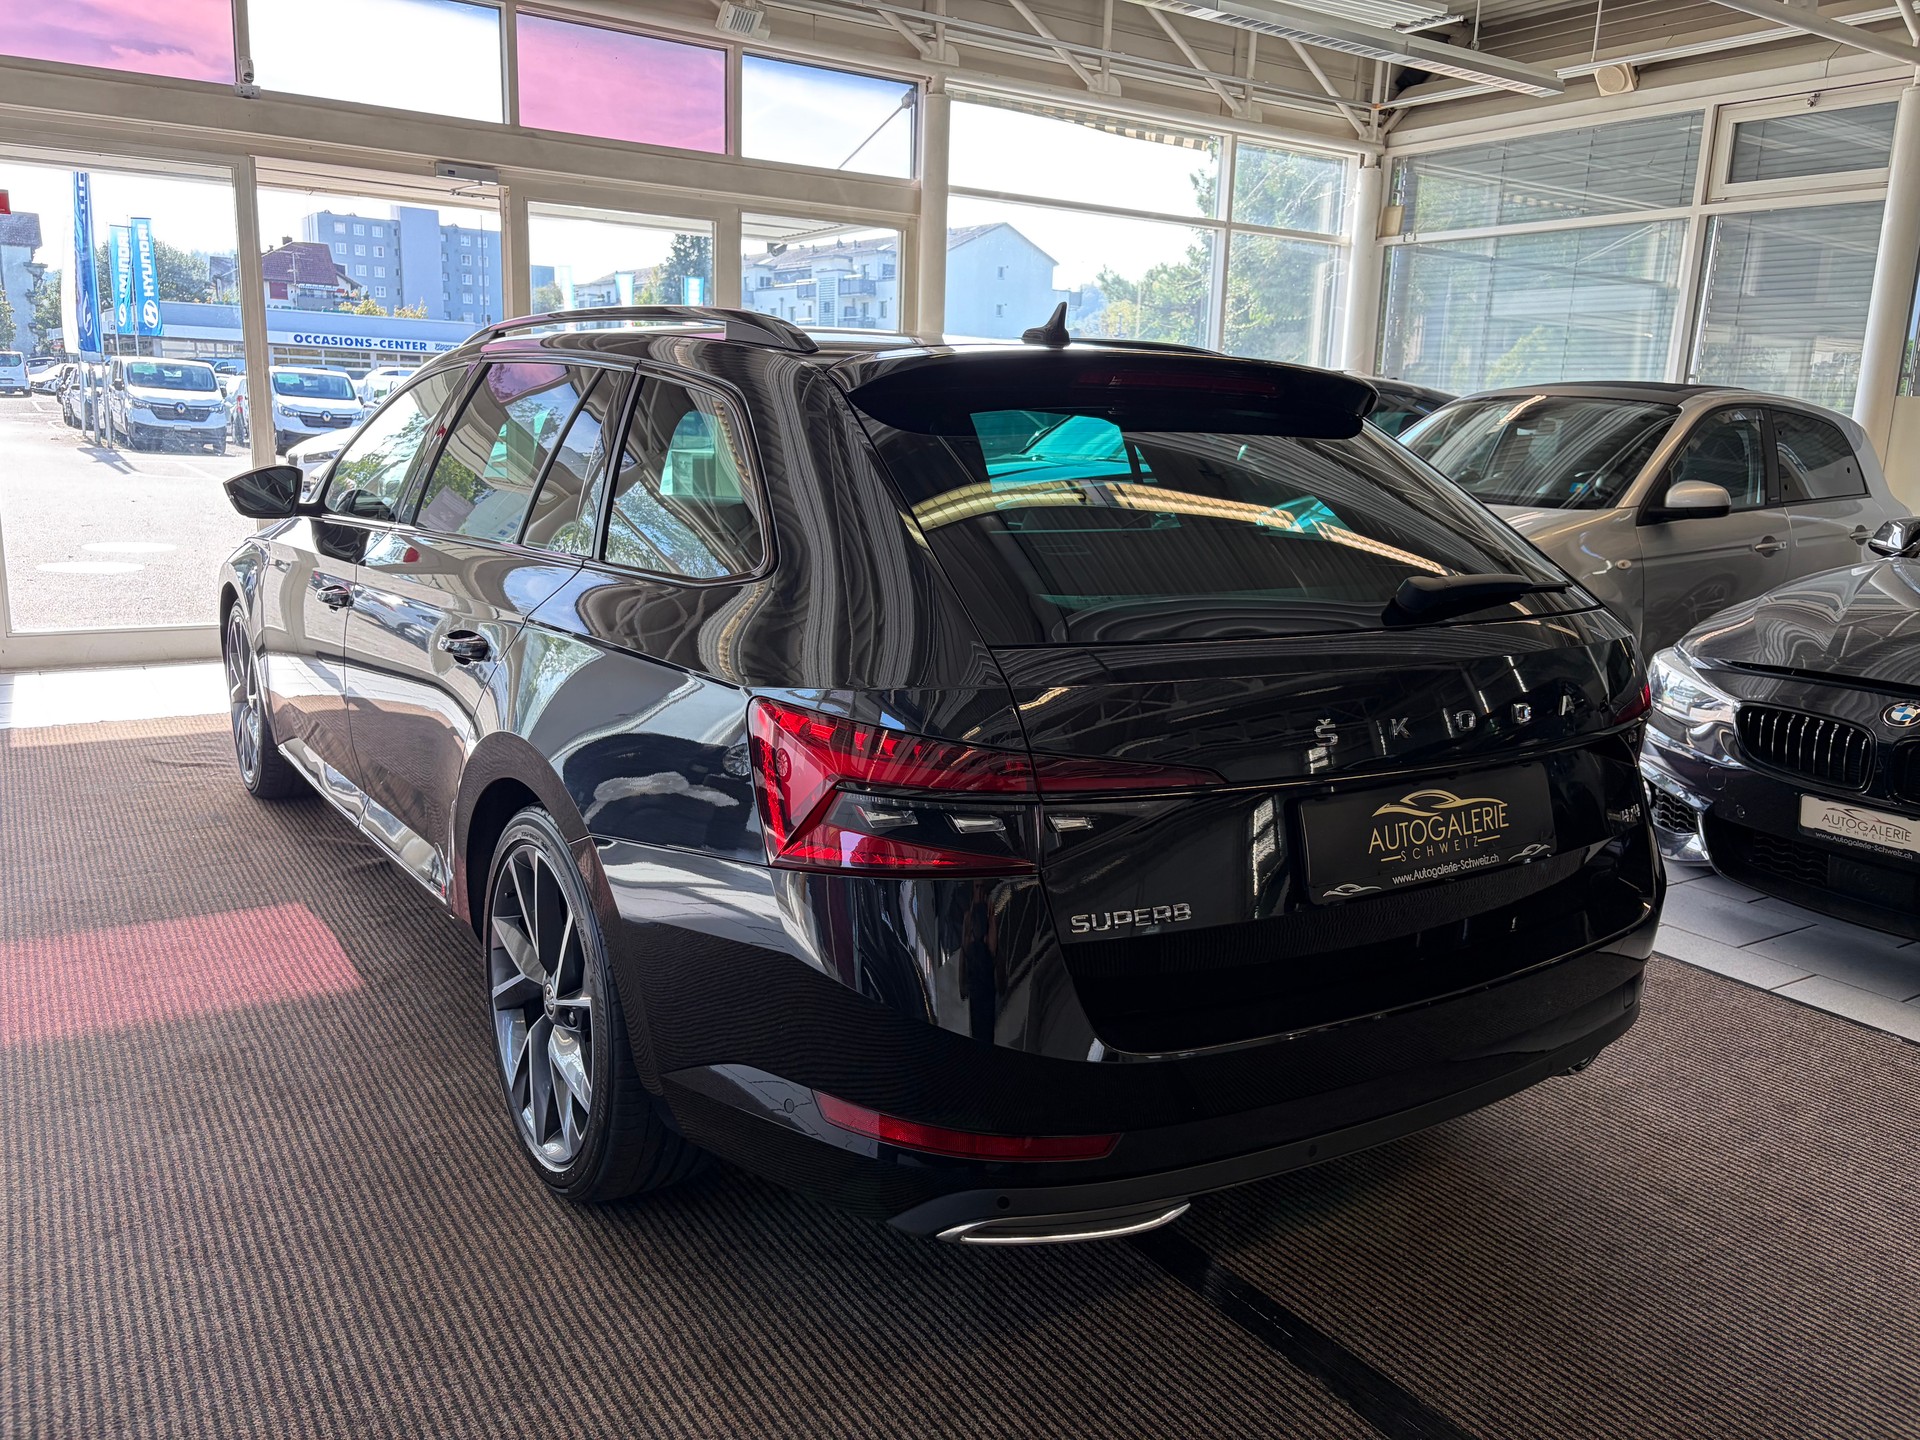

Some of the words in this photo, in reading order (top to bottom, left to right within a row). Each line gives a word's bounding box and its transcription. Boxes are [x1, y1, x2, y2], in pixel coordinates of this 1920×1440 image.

[137, 223, 155, 297] HYUNDAI
[293, 333, 428, 351] OCCASIONS-CENTER
[1368, 803, 1510, 854] AUTOGALERIE
[1821, 813, 1912, 842] AUTOGALERIE
[1400, 836, 1479, 862] SCHWEIZ
[1815, 832, 1913, 860] www.Autogalerie-Schweiz.ch
[1392, 853, 1500, 885] www.Autogalerie-Schweiz.ch
[1070, 902, 1192, 933] SUPERB
